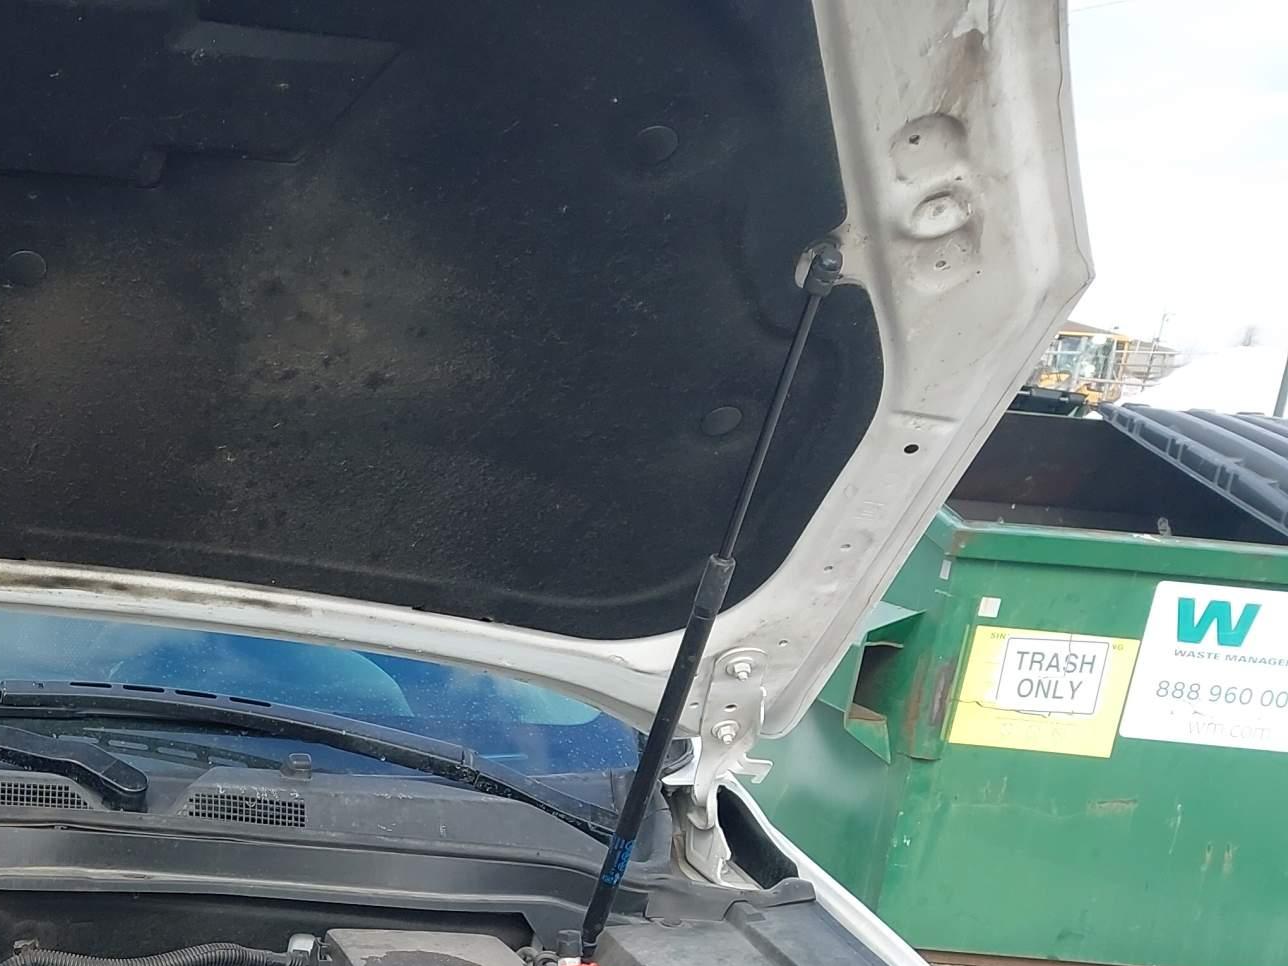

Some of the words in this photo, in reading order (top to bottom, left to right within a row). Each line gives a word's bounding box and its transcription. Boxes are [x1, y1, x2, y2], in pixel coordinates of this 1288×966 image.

[1015, 650, 1097, 674] TRASH
[1173, 648, 1221, 661] WASTE
[1016, 677, 1084, 701] ONLY
[1155, 679, 1201, 701] 888
[1208, 683, 1254, 705] 960
